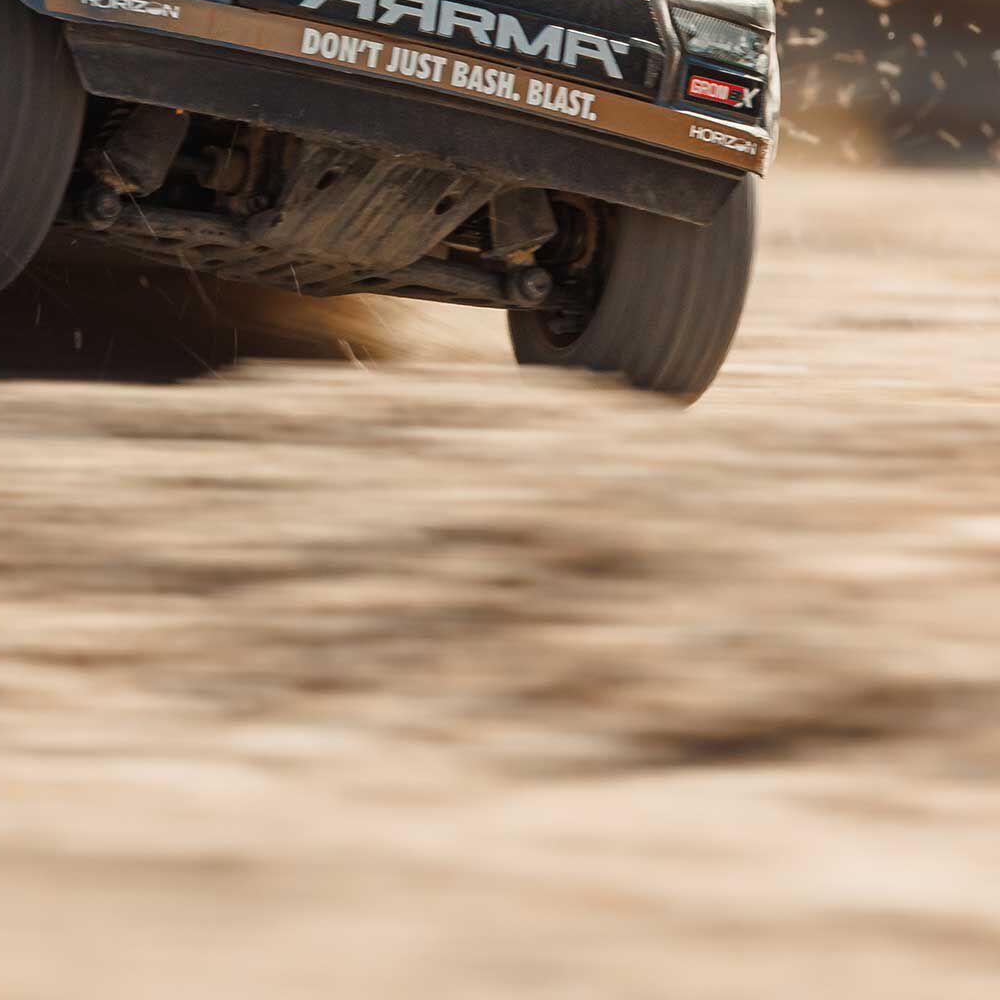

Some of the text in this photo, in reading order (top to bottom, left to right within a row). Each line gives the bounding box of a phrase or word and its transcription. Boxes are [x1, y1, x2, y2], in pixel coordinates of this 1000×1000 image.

[301, 27, 598, 122] DON'T JUST BASH. BLAST.
